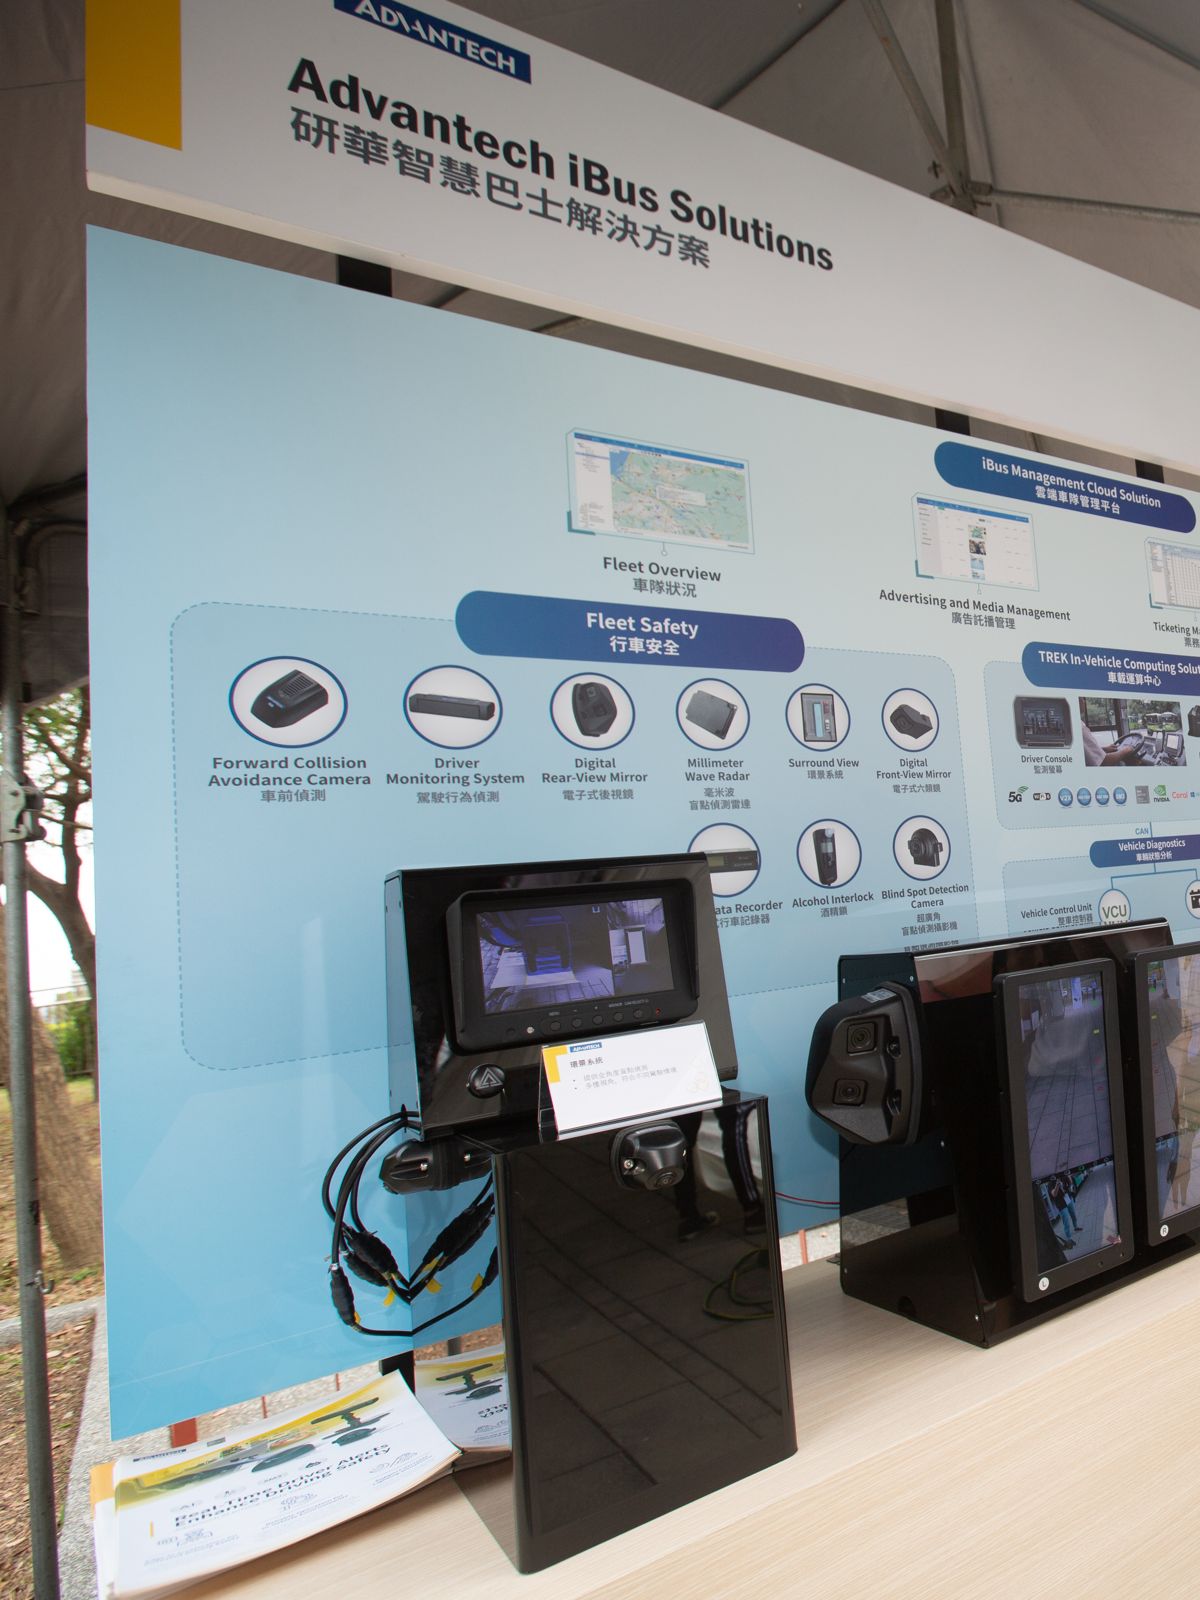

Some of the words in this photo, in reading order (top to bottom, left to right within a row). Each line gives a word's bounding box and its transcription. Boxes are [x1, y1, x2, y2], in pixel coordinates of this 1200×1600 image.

[355, 0, 516, 75] ADVANTECH
[287, 57, 556, 180] Advantech
[568, 155, 660, 213] iBus
[670, 190, 835, 272] Solutions
[289, 105, 712, 270] 研華智慧巴士解決方案
[981, 456, 1009, 475] iBus
[1011, 464, 1085, 493] Management
[1087, 481, 1118, 499] Cloud
[1119, 488, 1162, 509] Solution
[1035, 484, 1121, 515] 雲端車隊管理平台
[602, 556, 645, 574] Fleet
[647, 562, 722, 583] Overview
[632, 578, 697, 599] 車隊狀況
[879, 589, 948, 610] Advertising
[949, 597, 970, 611] and
[971, 600, 1005, 614] Media
[1006, 604, 1072, 622] Management
[585, 611, 636, 633] Fleet
[640, 615, 699, 640] Safety
[951, 610, 1017, 630] 廣告託播管理
[1153, 621, 1190, 636] Ticketing
[609, 635, 681, 657] 行車安全
[1038, 650, 1069, 665] TREK
[1070, 653, 1122, 669] In-Vehicle
[1123, 658, 1177, 676] Computing
[1107, 671, 1162, 687] 車載運算中心
[212, 756, 290, 769] Forward
[294, 756, 367, 769] Collision
[434, 757, 480, 769] Driver
[575, 758, 617, 770] Digital
[687, 758, 744, 769] Millimeter
[788, 758, 835, 768] Surround
[836, 758, 860, 768] View
[899, 758, 928, 769] Digital
[1021, 754, 1043, 763] Driver
[1045, 755, 1073, 764] Console
[208, 772, 303, 786] Avoidance
[306, 772, 371, 785] Camera
[386, 772, 471, 787] Monitoring
[473, 773, 525, 786] System
[541, 772, 607, 783] Rear-View
[610, 772, 648, 783] Mirror
[685, 771, 714, 782] Wave
[716, 770, 750, 782] Radar
[876, 770, 924, 779] Front-View
[925, 770, 952, 778] Mirror
[260, 788, 327, 803] 車前偵測
[416, 790, 500, 804] 駕駛行為偵測
[562, 788, 635, 801] 電子式後視鏡
[703, 787, 735, 798] 毫米波
[1008, 791, 1023, 803] 5G
[1118, 841, 1146, 852] Vehicle
[1146, 838, 1186, 851] Diagnostics
[881, 889, 906, 900] Blind
[907, 887, 928, 899] Spot
[929, 883, 970, 897] Detection
[715, 903, 733, 915] ata
[735, 899, 784, 914] Recorder
[792, 895, 830, 908] Alcohol
[831, 891, 874, 906] Interlock
[911, 898, 944, 910] Camera
[1020, 908, 1048, 919] Vehicle
[1049, 905, 1076, 915] Control
[1078, 903, 1093, 912] Unit
[1102, 904, 1127, 919] VCU
[716, 913, 770, 929] 行車記錄器
[175, 1505, 217, 1523] Real
[228, 1487, 273, 1506] Time
[278, 1464, 331, 1488] Driver
[338, 1443, 389, 1466] Alerts
[175, 1497, 260, 1527] Enhance
[265, 1470, 333, 1498] Driving
[336, 1447, 391, 1472] Safety
